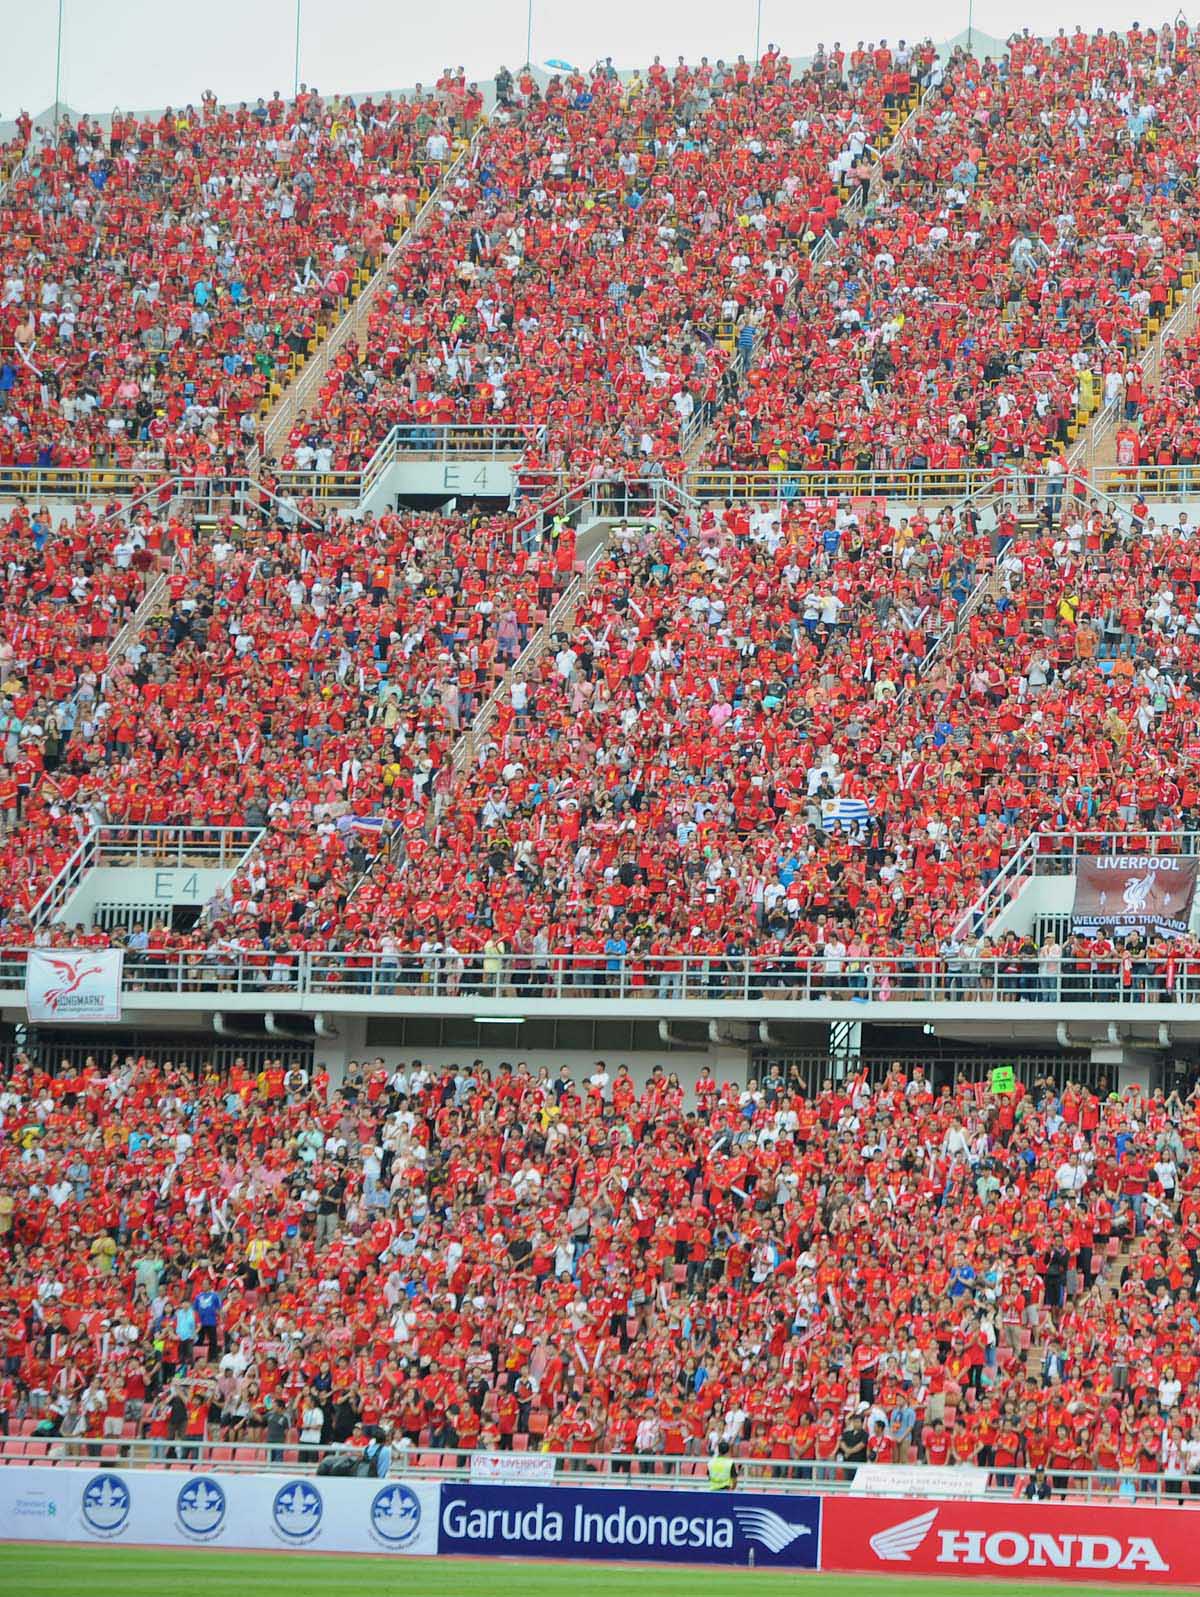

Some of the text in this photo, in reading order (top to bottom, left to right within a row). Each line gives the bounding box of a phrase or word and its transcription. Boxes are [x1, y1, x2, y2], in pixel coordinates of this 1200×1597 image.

[1096, 856, 1181, 872] LIVERPOOL
[1072, 914, 1187, 931] WELCOME TO THAILAND
[443, 1500, 563, 1541] Garuda
[574, 1501, 734, 1549] Indonesia
[937, 1529, 1169, 1571] HONDA
